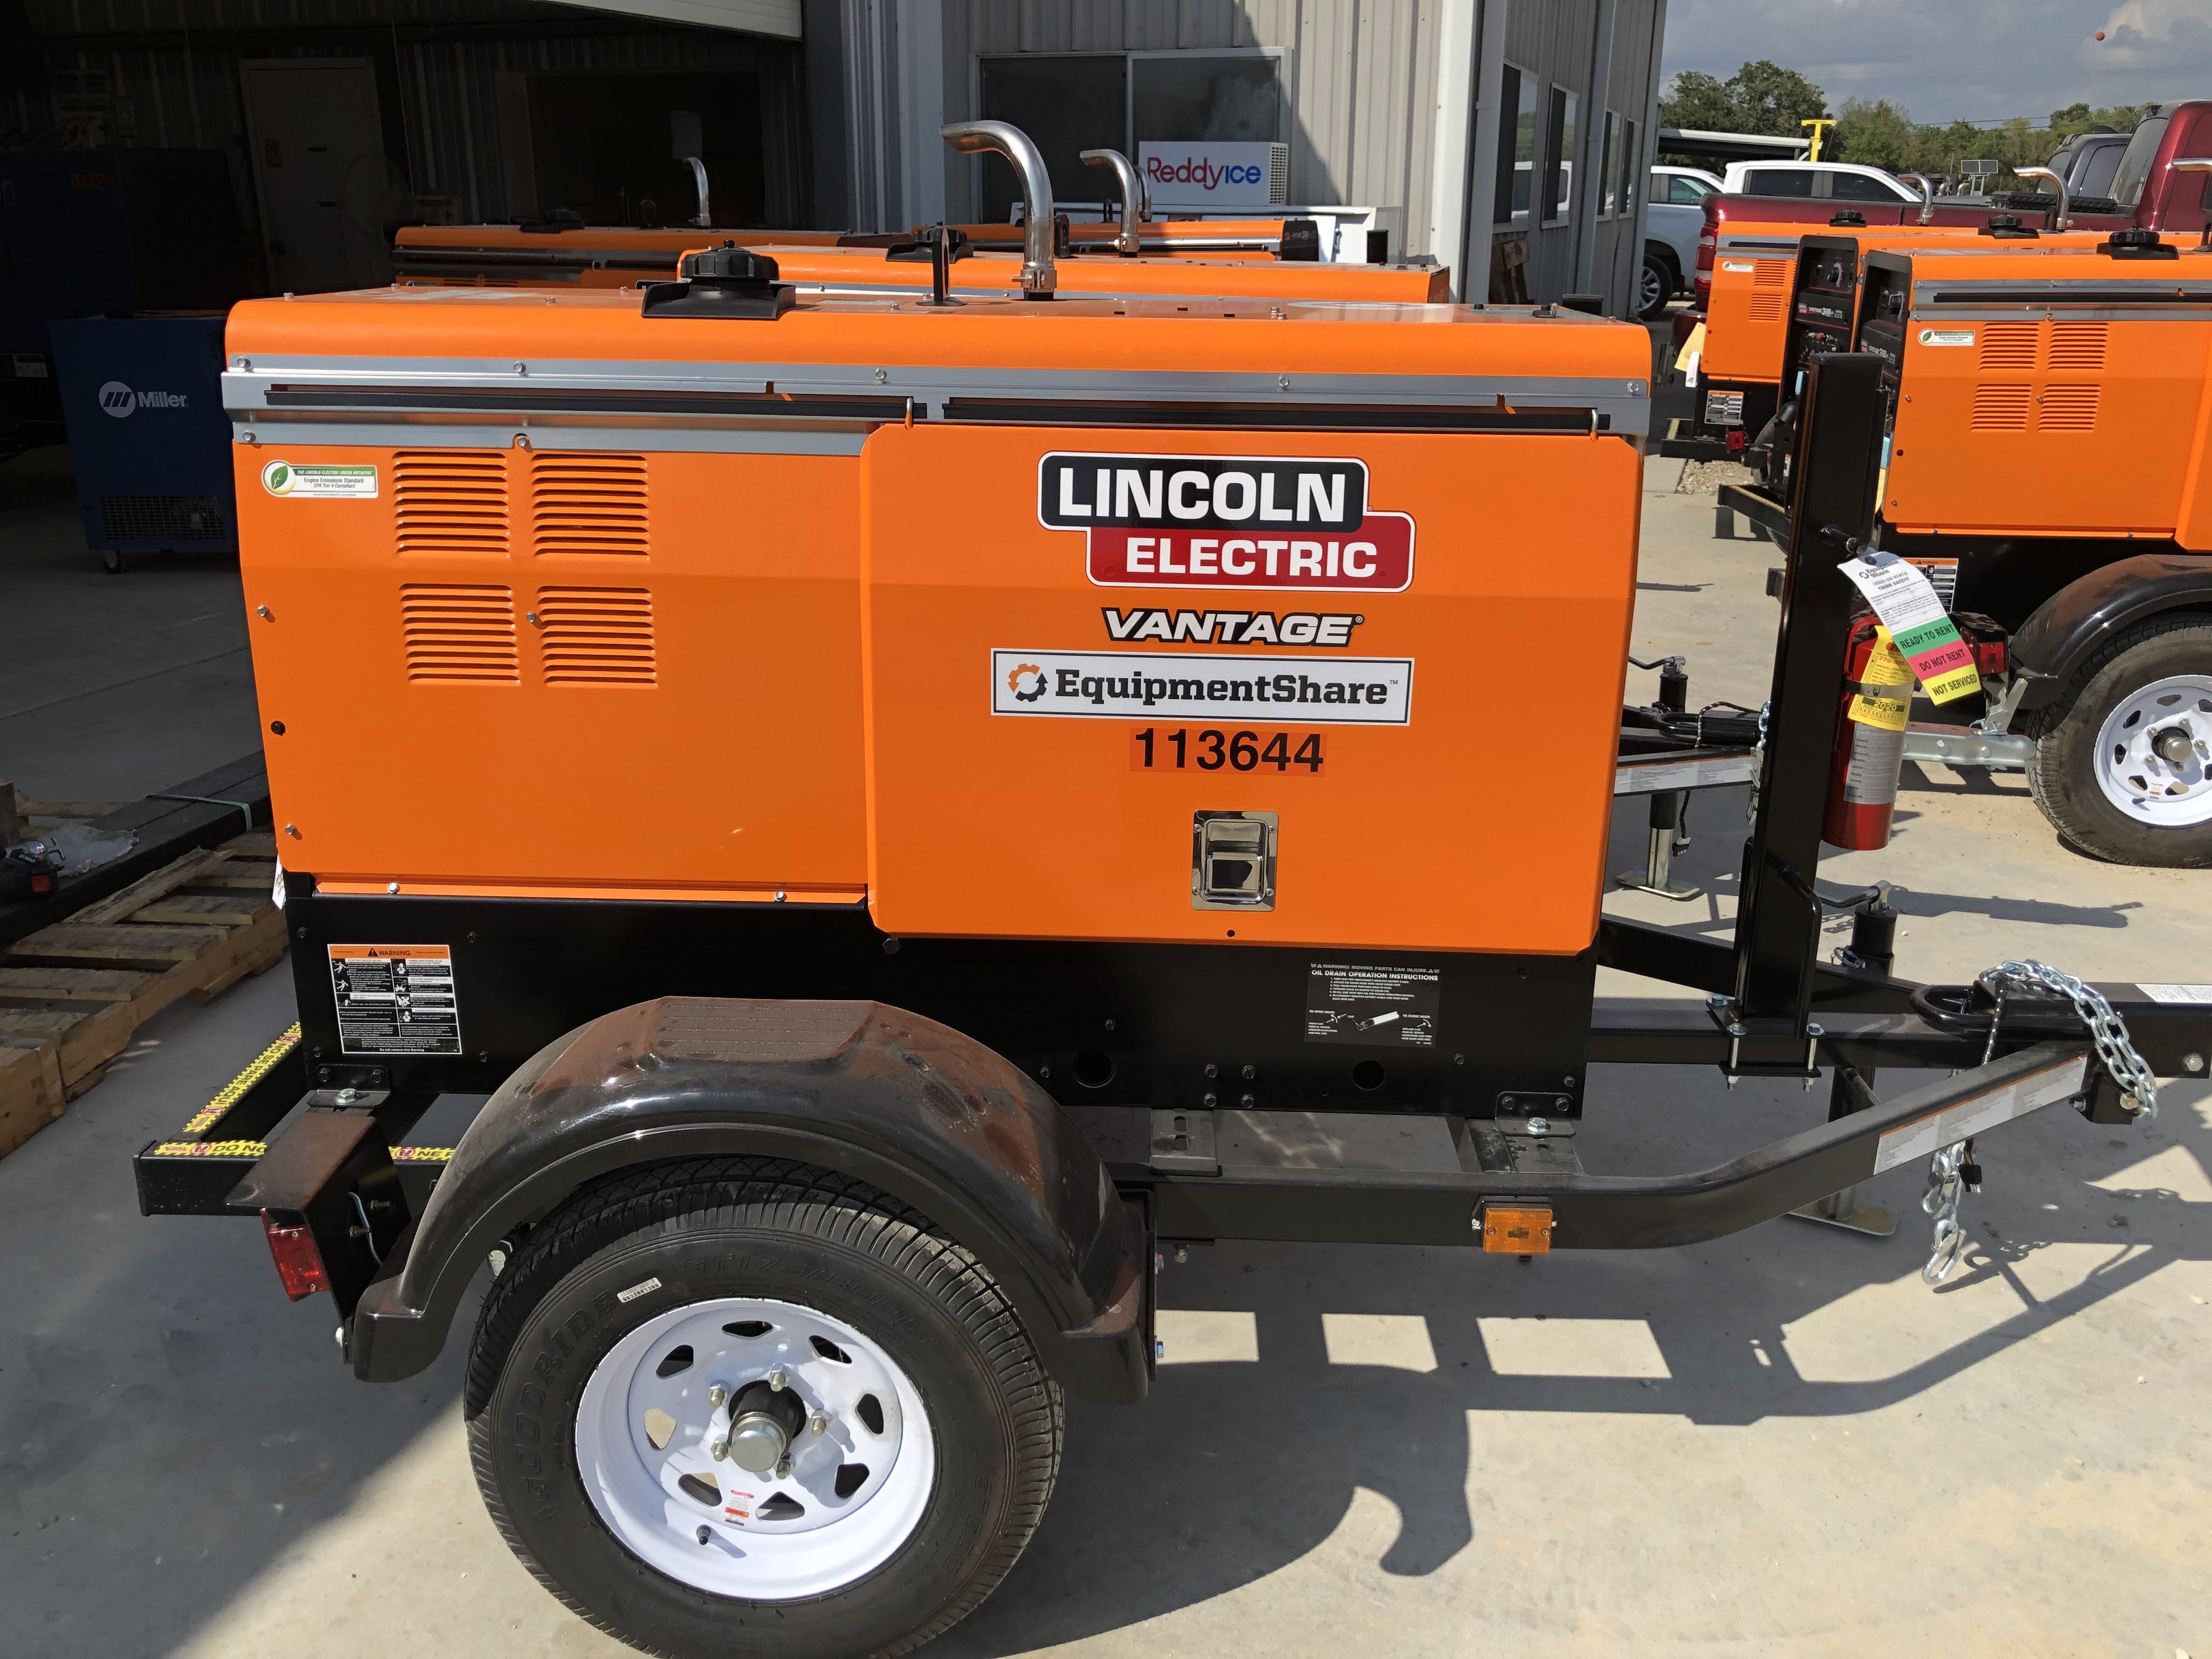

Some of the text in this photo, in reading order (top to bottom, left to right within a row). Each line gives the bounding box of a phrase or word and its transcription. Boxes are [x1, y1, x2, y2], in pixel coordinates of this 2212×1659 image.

[138, 391, 187, 407] Miller
[1059, 467, 1346, 522] LINCOLN
[1126, 537, 1377, 578] ELECTRIC
[1865, 560, 1900, 574] Equipment
[1878, 576, 1910, 591] THINK SAFETY
[1104, 609, 1354, 645] VANTAGE
[1899, 623, 1955, 650] READY TO RENT
[1919, 648, 1966, 672] DO NOT RENT
[1055, 669, 1389, 706] EquipmentShare
[1932, 674, 1978, 696] NOT SERVICED
[1874, 701, 1897, 712] 2020
[1135, 727, 1324, 772] 113644
[1389, 973, 1438, 981] INSTRUCTIONS
[270, 1042, 289, 1054] NO
[258, 1054, 275, 1065] SE
[236, 1065, 264, 1085] PARE
[514, 1288, 616, 1502] GOODRIDE
